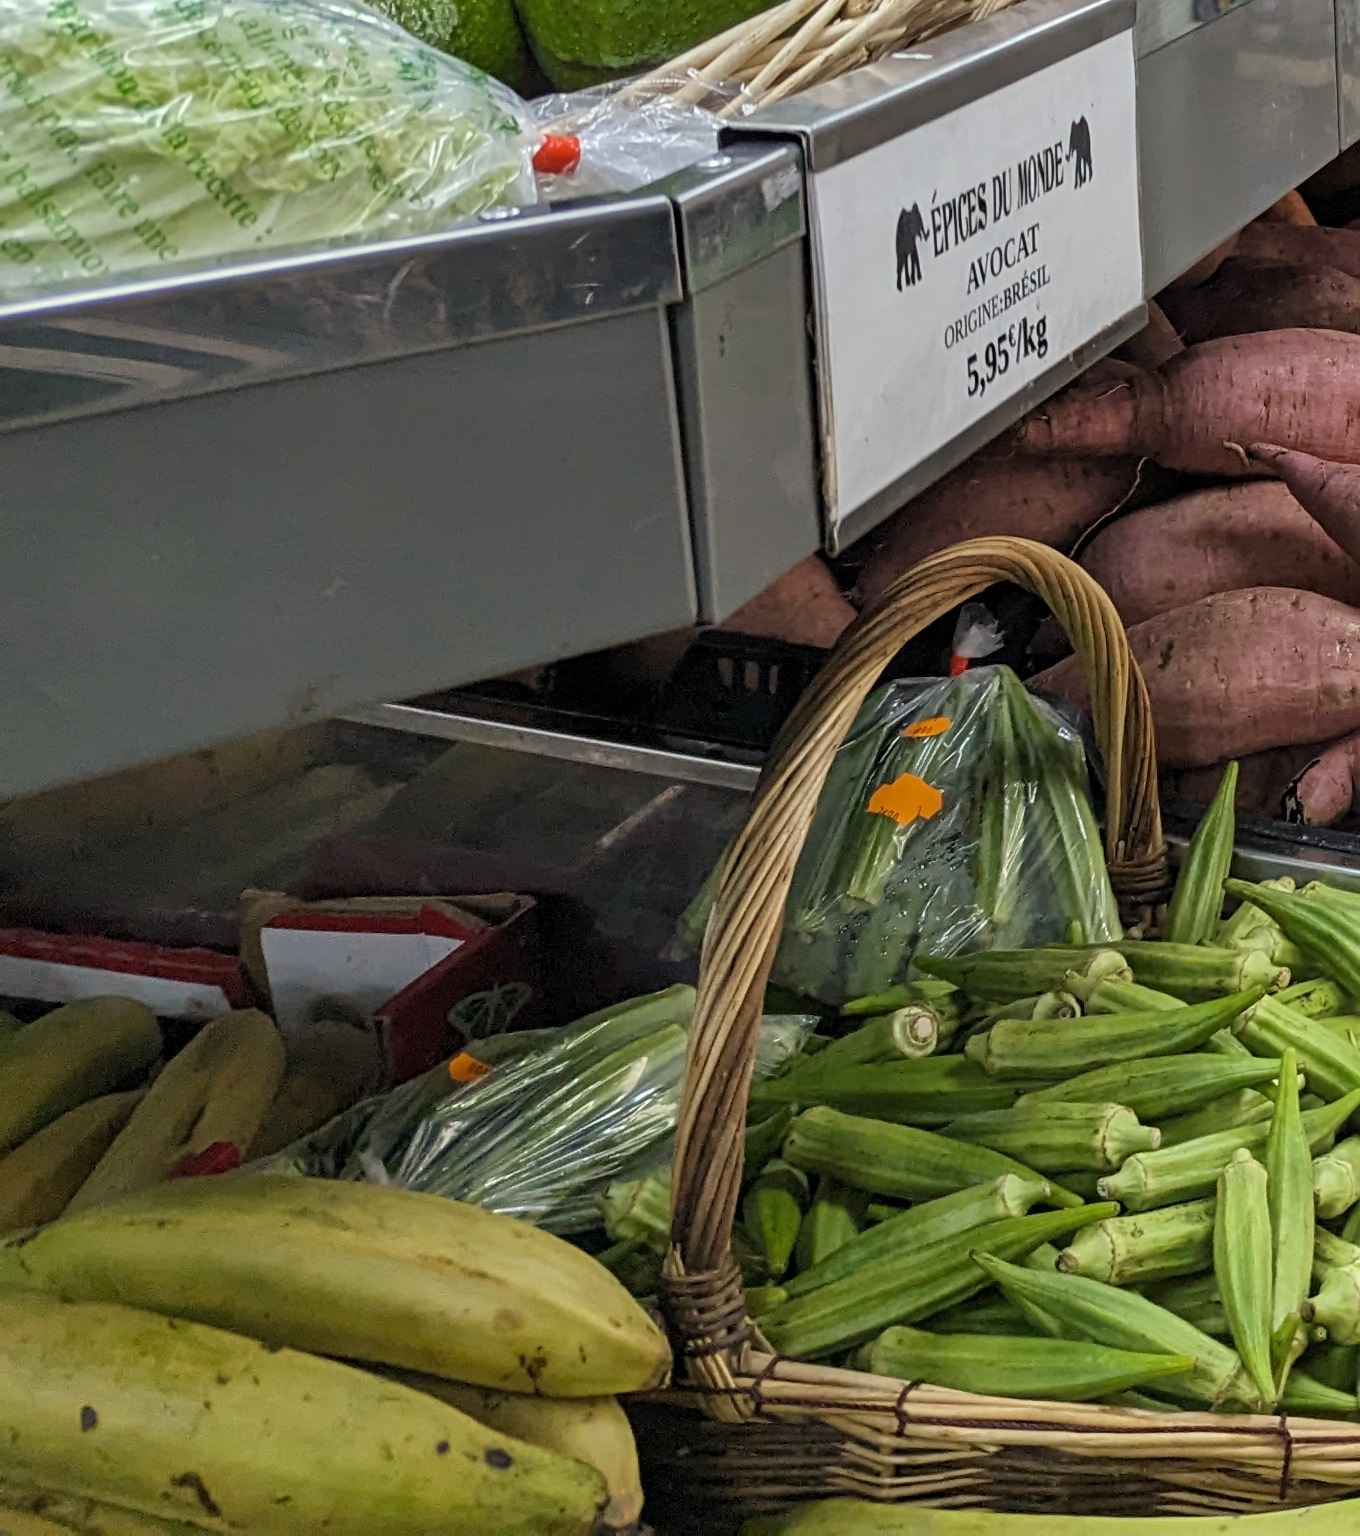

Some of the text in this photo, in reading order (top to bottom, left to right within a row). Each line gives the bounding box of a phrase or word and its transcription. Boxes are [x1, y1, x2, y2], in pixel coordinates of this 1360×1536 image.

[929, 140, 1065, 259] ÉPICES DU MONDE
[965, 223, 1042, 296] AVOCAT
[943, 263, 1052, 350] ORIGINE:BRÉSIL
